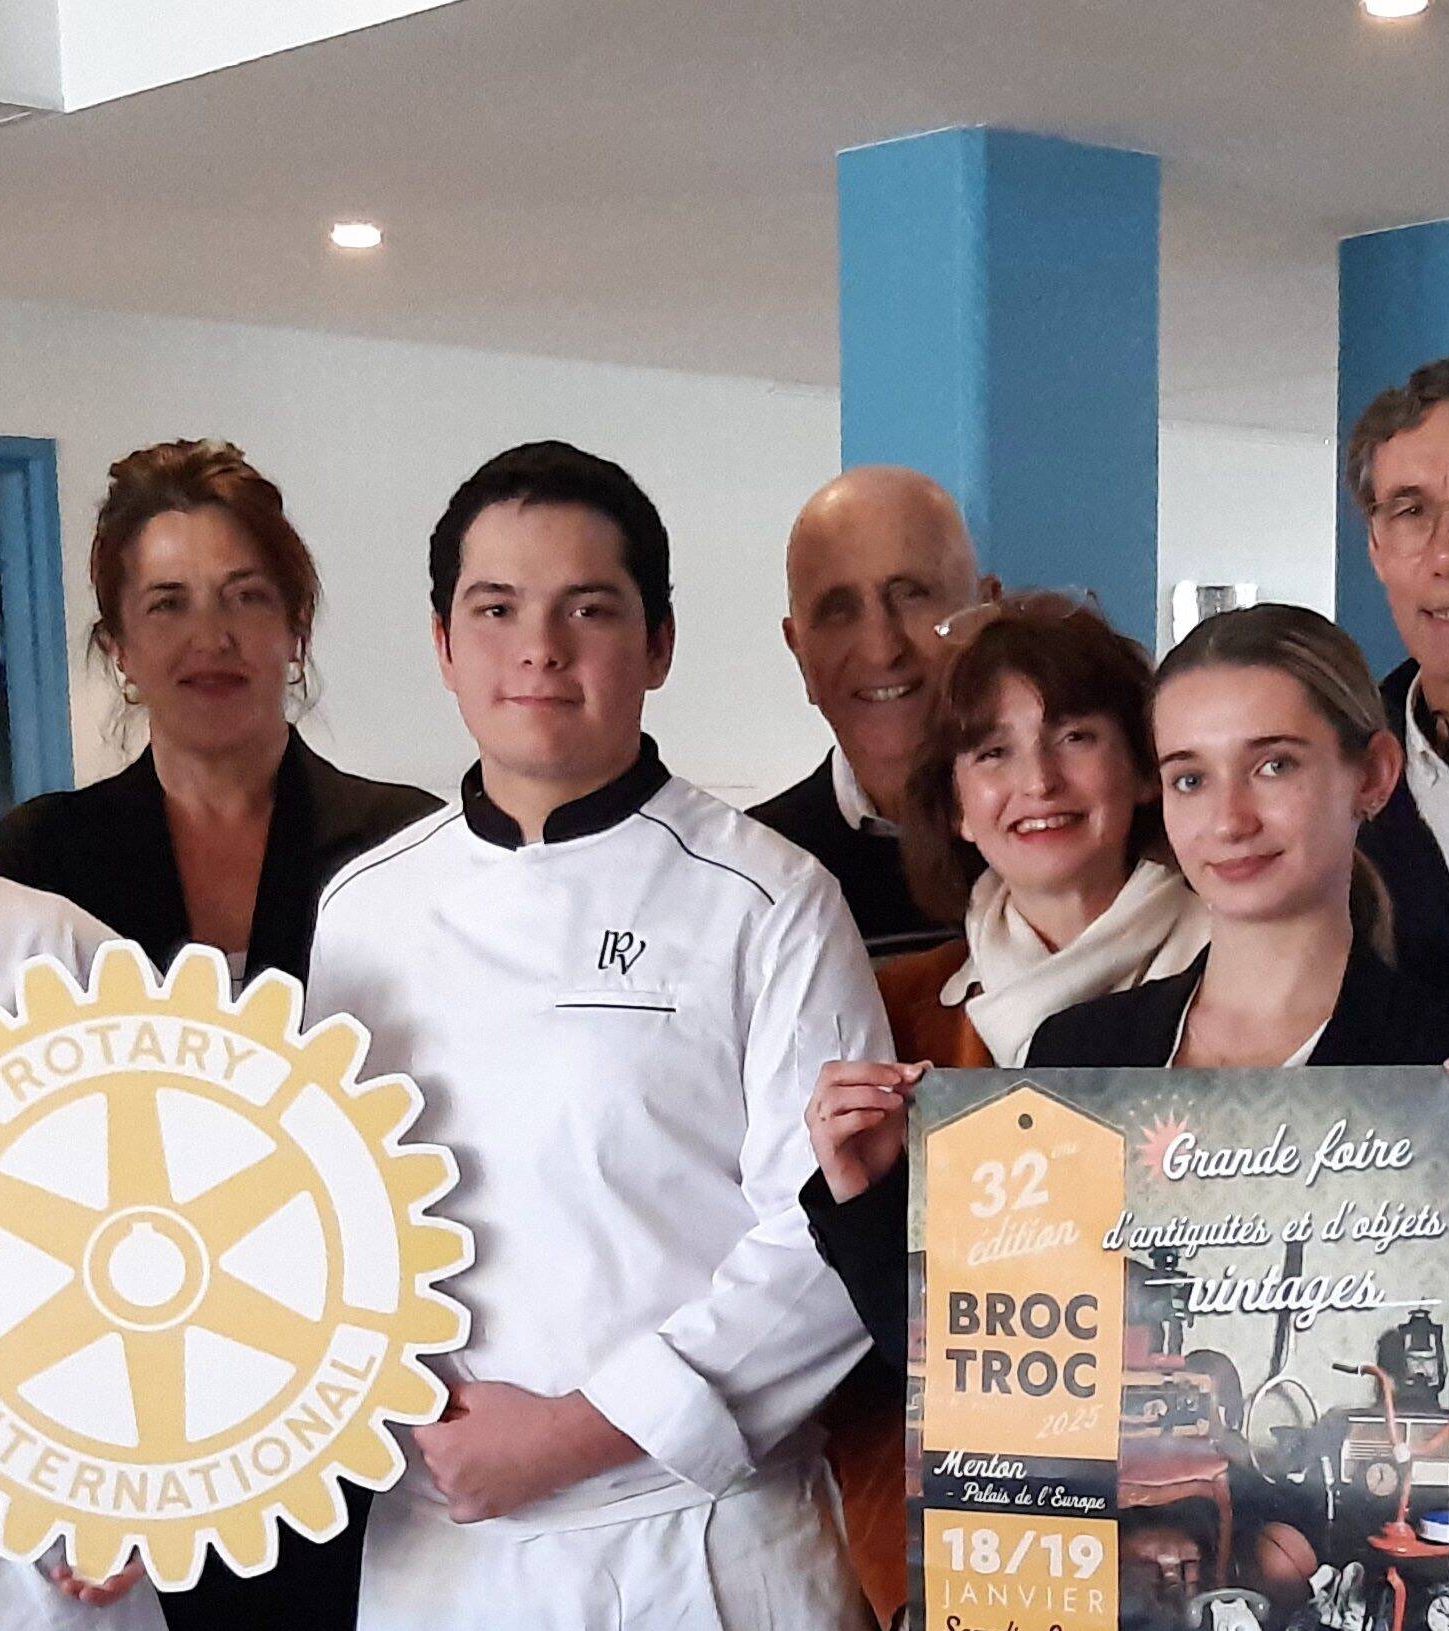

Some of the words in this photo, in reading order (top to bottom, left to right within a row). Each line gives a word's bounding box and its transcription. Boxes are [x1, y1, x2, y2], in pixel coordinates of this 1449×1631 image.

[1, 1022, 258, 1102] ROTARY
[1161, 1124, 1301, 1182] Grande
[1304, 1118, 1414, 1186] foire
[969, 1149, 1050, 1219] 32
[966, 1216, 1080, 1267] édition
[1102, 1206, 1273, 1260] d'antiquités
[1282, 1213, 1315, 1245] et
[1321, 1201, 1447, 1254] d'objets
[949, 1291, 1099, 1341] BROC
[1186, 1270, 1386, 1329] vintages
[945, 1348, 1098, 1398] TROC
[1035, 1403, 1105, 1441] 2025
[933, 1448, 1028, 1480] Menton
[960, 1481, 1011, 1505] Palais
[1014, 1484, 1033, 1506] de
[1037, 1485, 1106, 1514] l'Europe
[942, 1527, 1104, 1579] 18/19
[942, 1579, 1104, 1614] JANVIER
